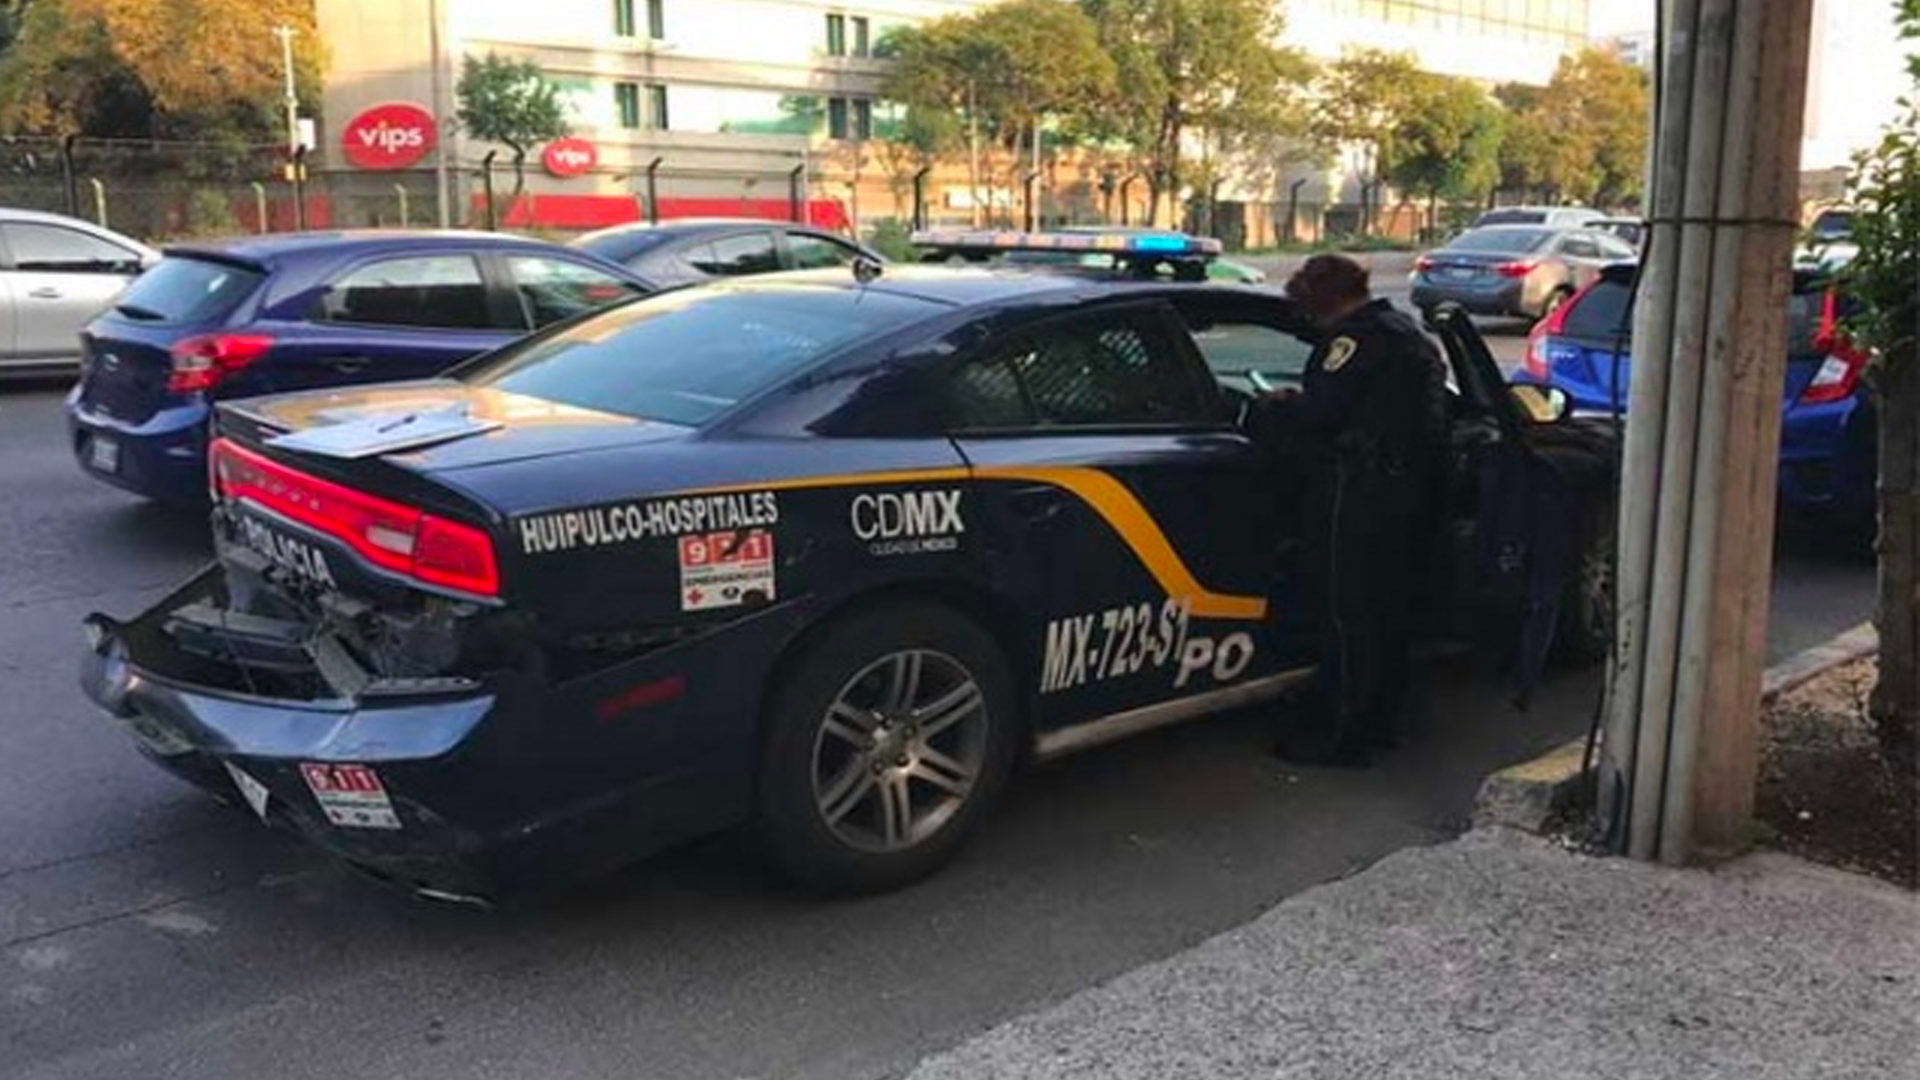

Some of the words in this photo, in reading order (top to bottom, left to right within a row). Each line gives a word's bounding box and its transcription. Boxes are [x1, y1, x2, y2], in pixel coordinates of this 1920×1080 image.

[357, 120, 424, 154] vips
[553, 147, 591, 167] vips
[521, 492, 778, 553] HUIPULCO-HOSPITALES
[851, 489, 965, 539] CDMX
[243, 515, 336, 589] POLICIA
[1173, 631, 1255, 688] PO
